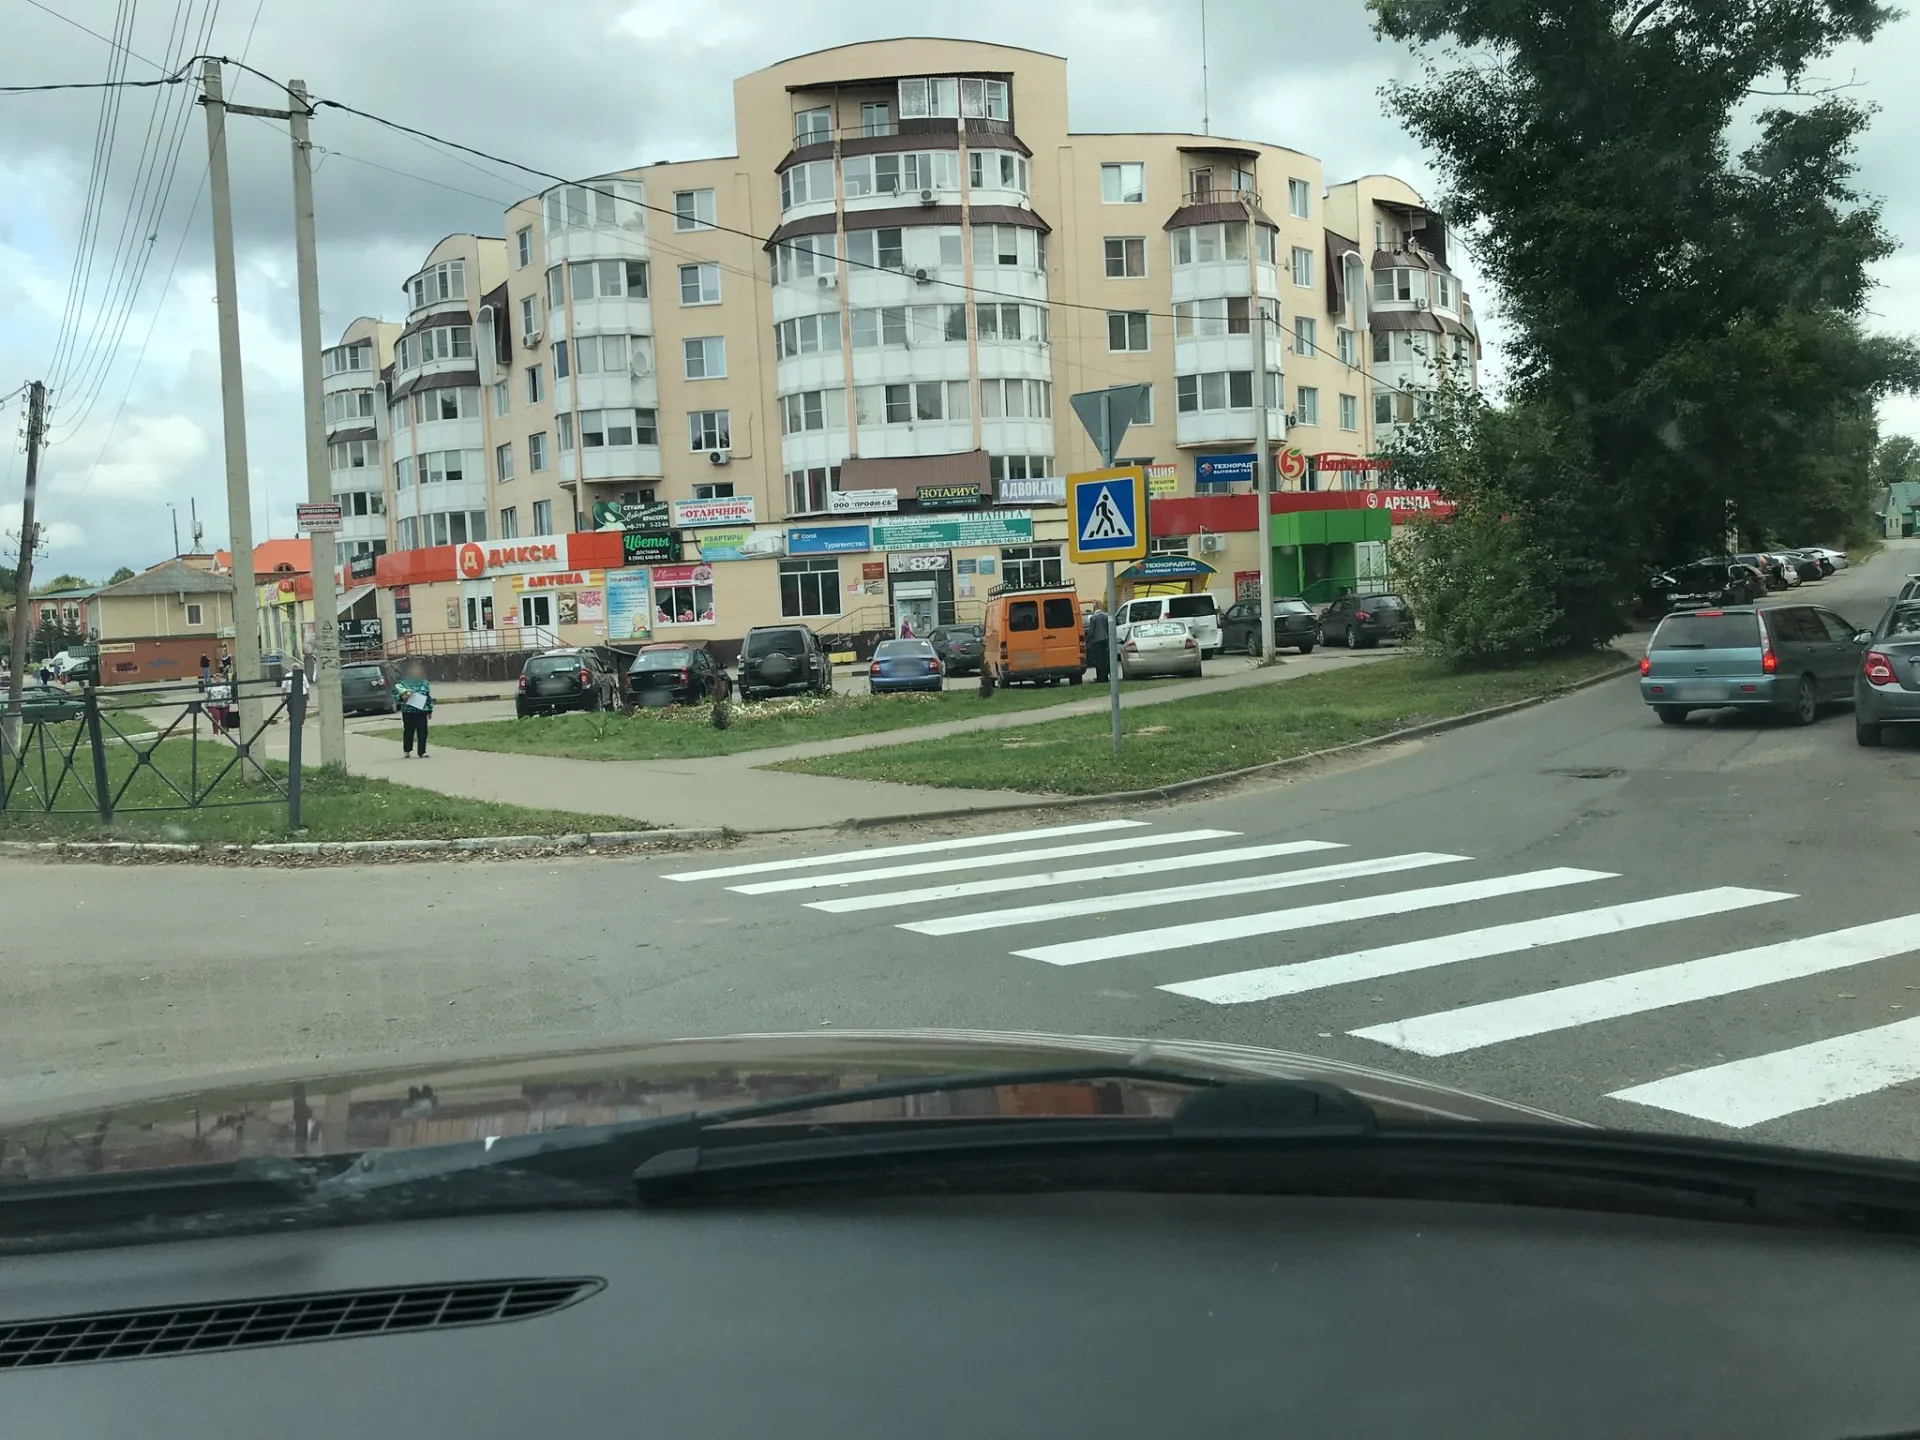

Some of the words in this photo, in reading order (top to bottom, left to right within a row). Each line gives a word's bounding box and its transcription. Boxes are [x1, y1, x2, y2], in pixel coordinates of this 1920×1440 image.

[920, 486, 979, 499] НОТАРИУС
[1001, 480, 1066, 499] АДВОКАТЫ
[624, 534, 670, 551] Цветы
[704, 534, 744, 543] КВАРТИРЫ
[823, 541, 866, 551] Турагентство
[487, 544, 557, 568] ДИКСИ
[1144, 561, 1196, 569] ТЕХНОРАДУГА
[528, 573, 584, 588] АПТЕКА
